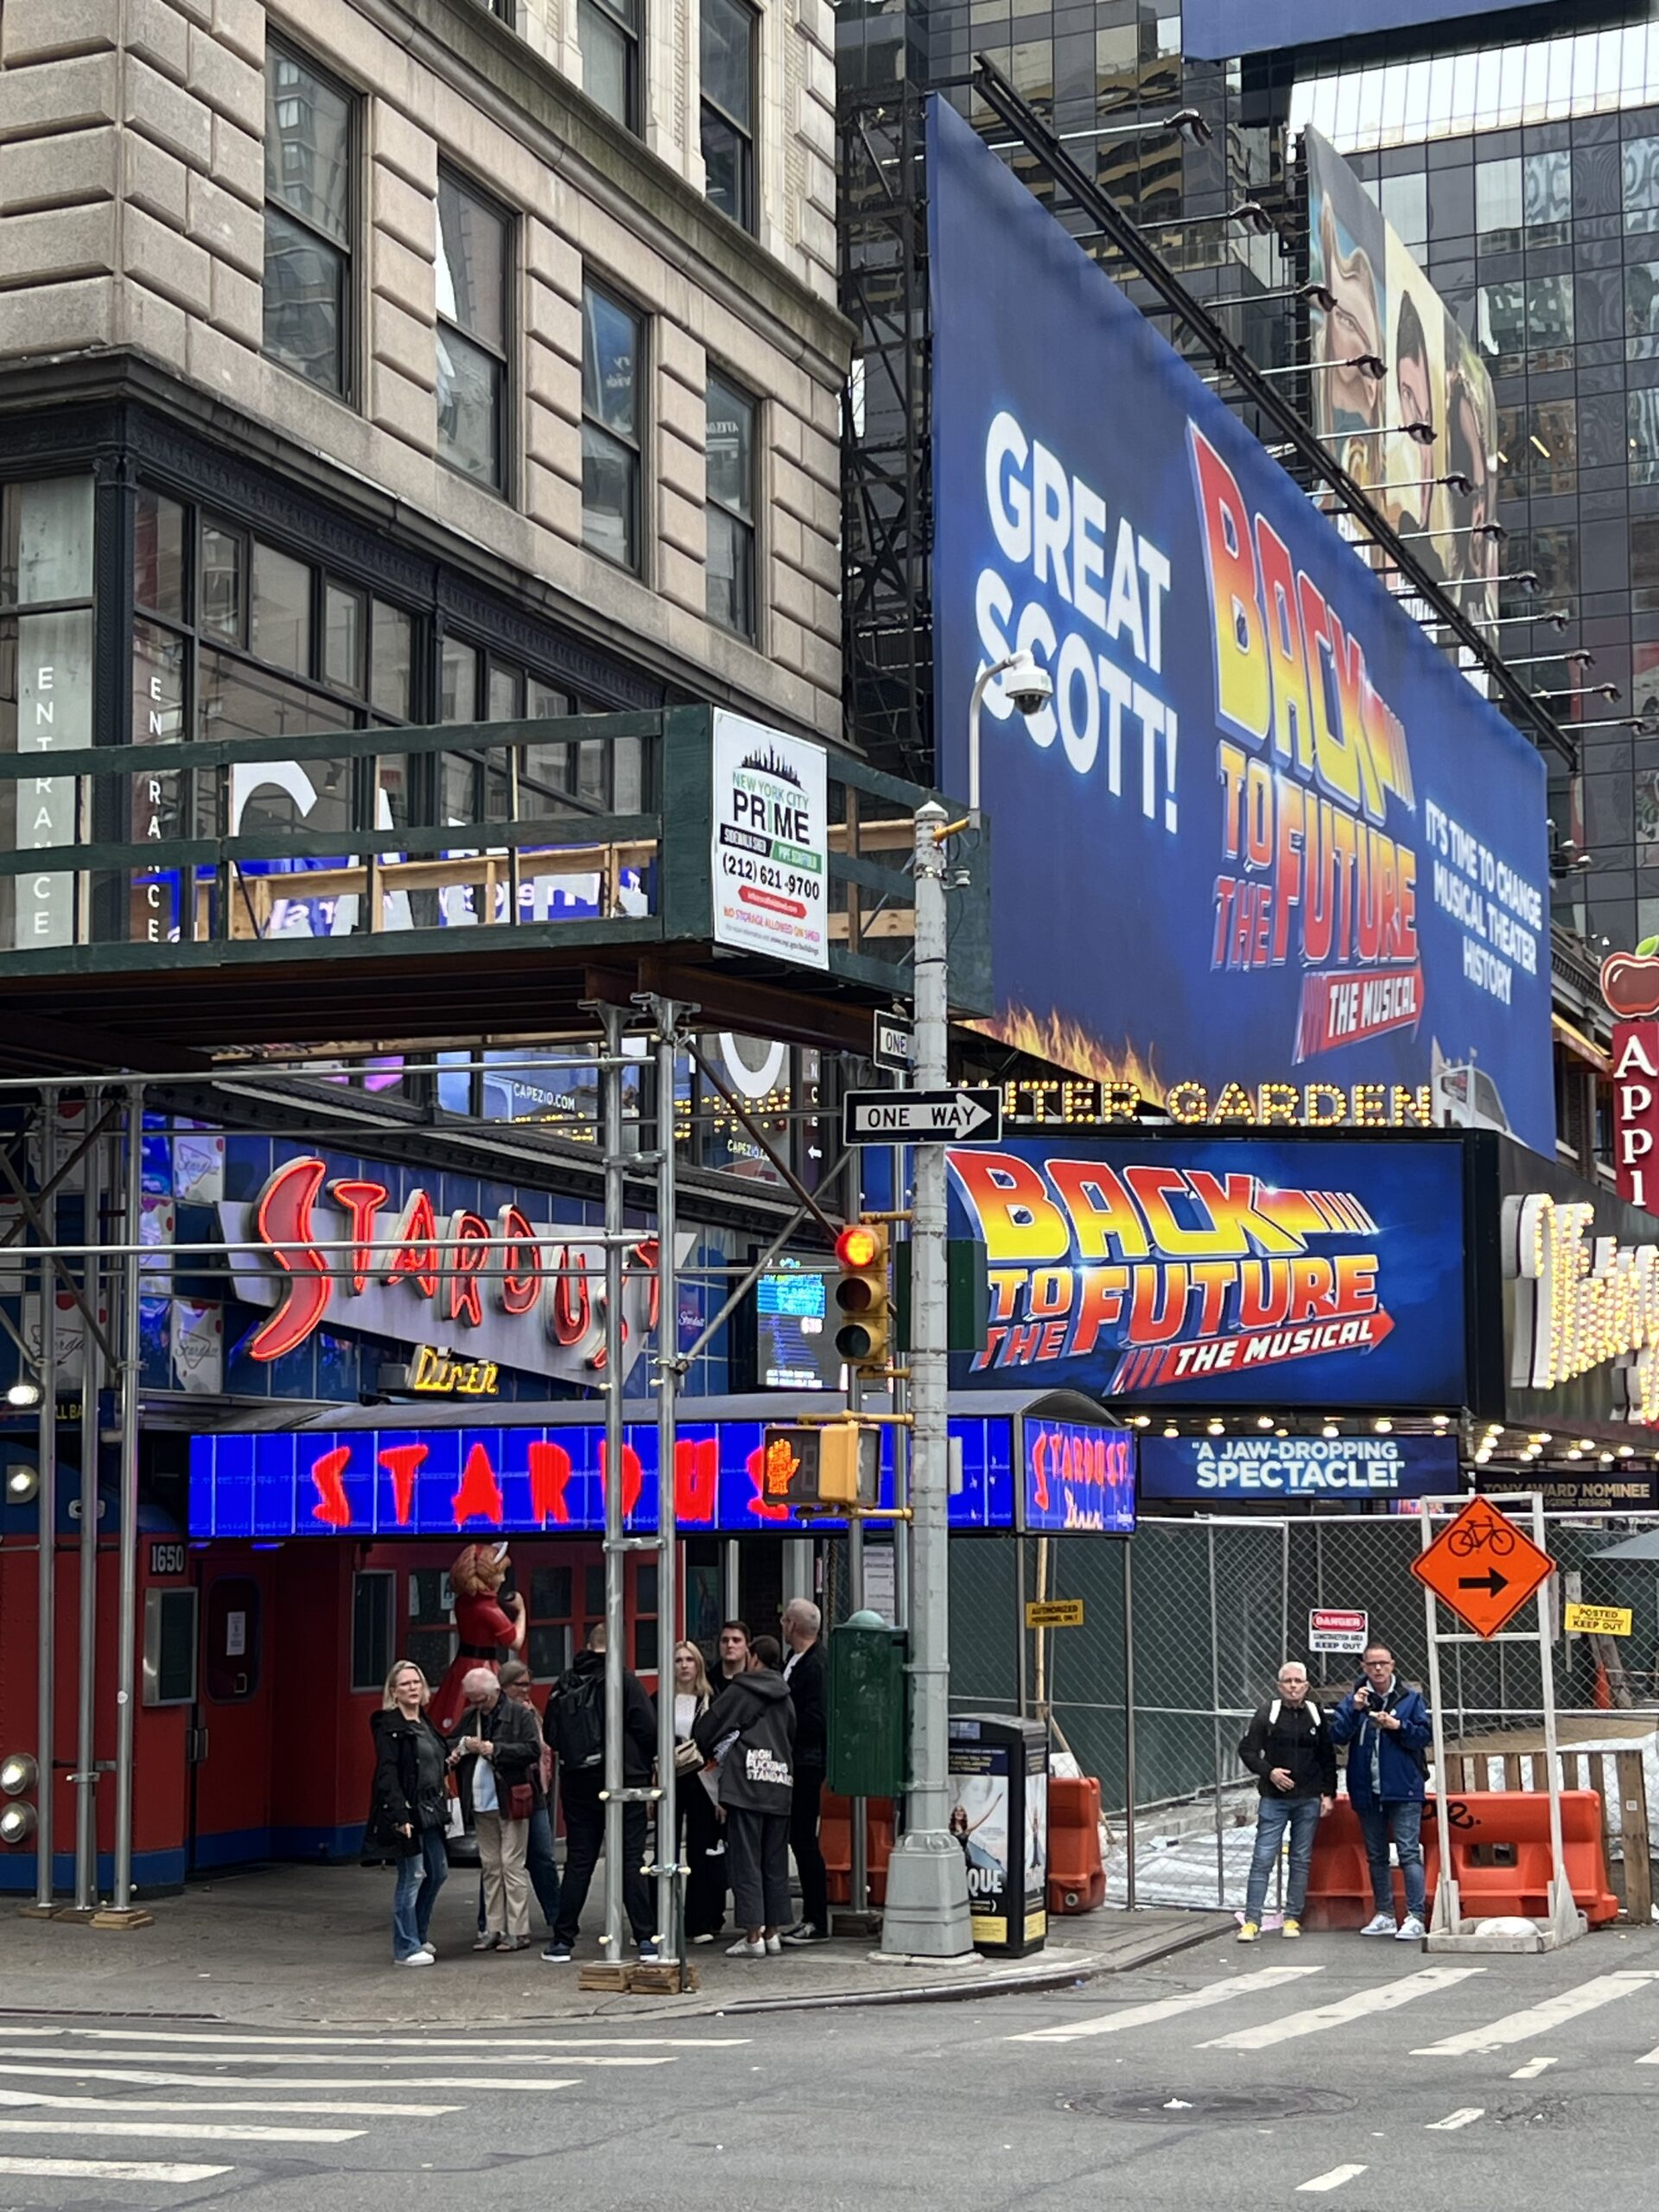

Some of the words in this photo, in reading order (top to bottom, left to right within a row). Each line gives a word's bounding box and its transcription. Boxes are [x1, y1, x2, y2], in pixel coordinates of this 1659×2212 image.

[985, 411, 1171, 675] GREAT
[1187, 418, 1389, 827] BACK
[976, 568, 1179, 836] SCOTT!
[33, 666, 54, 934] ENTRACE
[147, 676, 162, 943] ENRACE
[733, 771, 757, 792] NEW
[758, 780, 785, 804] YORK
[785, 791, 810, 810] CITY
[733, 787, 810, 846] PRIME
[1218, 739, 1273, 873] TO
[722, 852, 758, 884] (212)
[760, 865, 820, 900] 621-9700
[1270, 781, 1419, 966] FUTURE
[1426, 798, 1449, 856] IT'S
[1449, 819, 1478, 880] TIME
[1478, 843, 1496, 893] TO
[1496, 860, 1542, 931] CHANGE
[1211, 874, 1272, 972] THE
[1433, 860, 1487, 938] MUSICAL
[1486, 901, 1537, 976] THEATER
[1463, 935, 1512, 1005] HISTORY
[1328, 976, 1360, 1036] THE
[1359, 971, 1418, 1031] MUSICAL
[886, 1032, 907, 1055] ONE
[513, 1083, 575, 1112] CAPEZIO.COM
[868, 1108, 910, 1128] ONE
[931, 1106, 976, 1126] WAY
[1168, 1082, 1432, 1127] GARDEN
[946, 1149, 1309, 1264] BACK
[986, 1267, 1073, 1322] TO
[1071, 1254, 1380, 1357] FUTURE
[973, 1324, 1069, 1371] THE
[1173, 1340, 1240, 1376] THE
[1243, 1316, 1375, 1365] MUSICAL
[1032, 1431, 1129, 1512] STARDUST
[1220, 1441, 1399, 1460] JAW-DROPPING
[1578, 1498, 1612, 1508] DESIGN
[1582, 1483, 1651, 1498] NOMINEE
[151, 1545, 184, 1573] 1650
[1315, 1616, 1361, 1627] DANGER
[1573, 1620, 1599, 1629] KEEP
[1580, 1608, 1618, 1618] POSTED
[746, 1758, 788, 1774] FUCKING
[747, 1749, 772, 1760] HIGH
